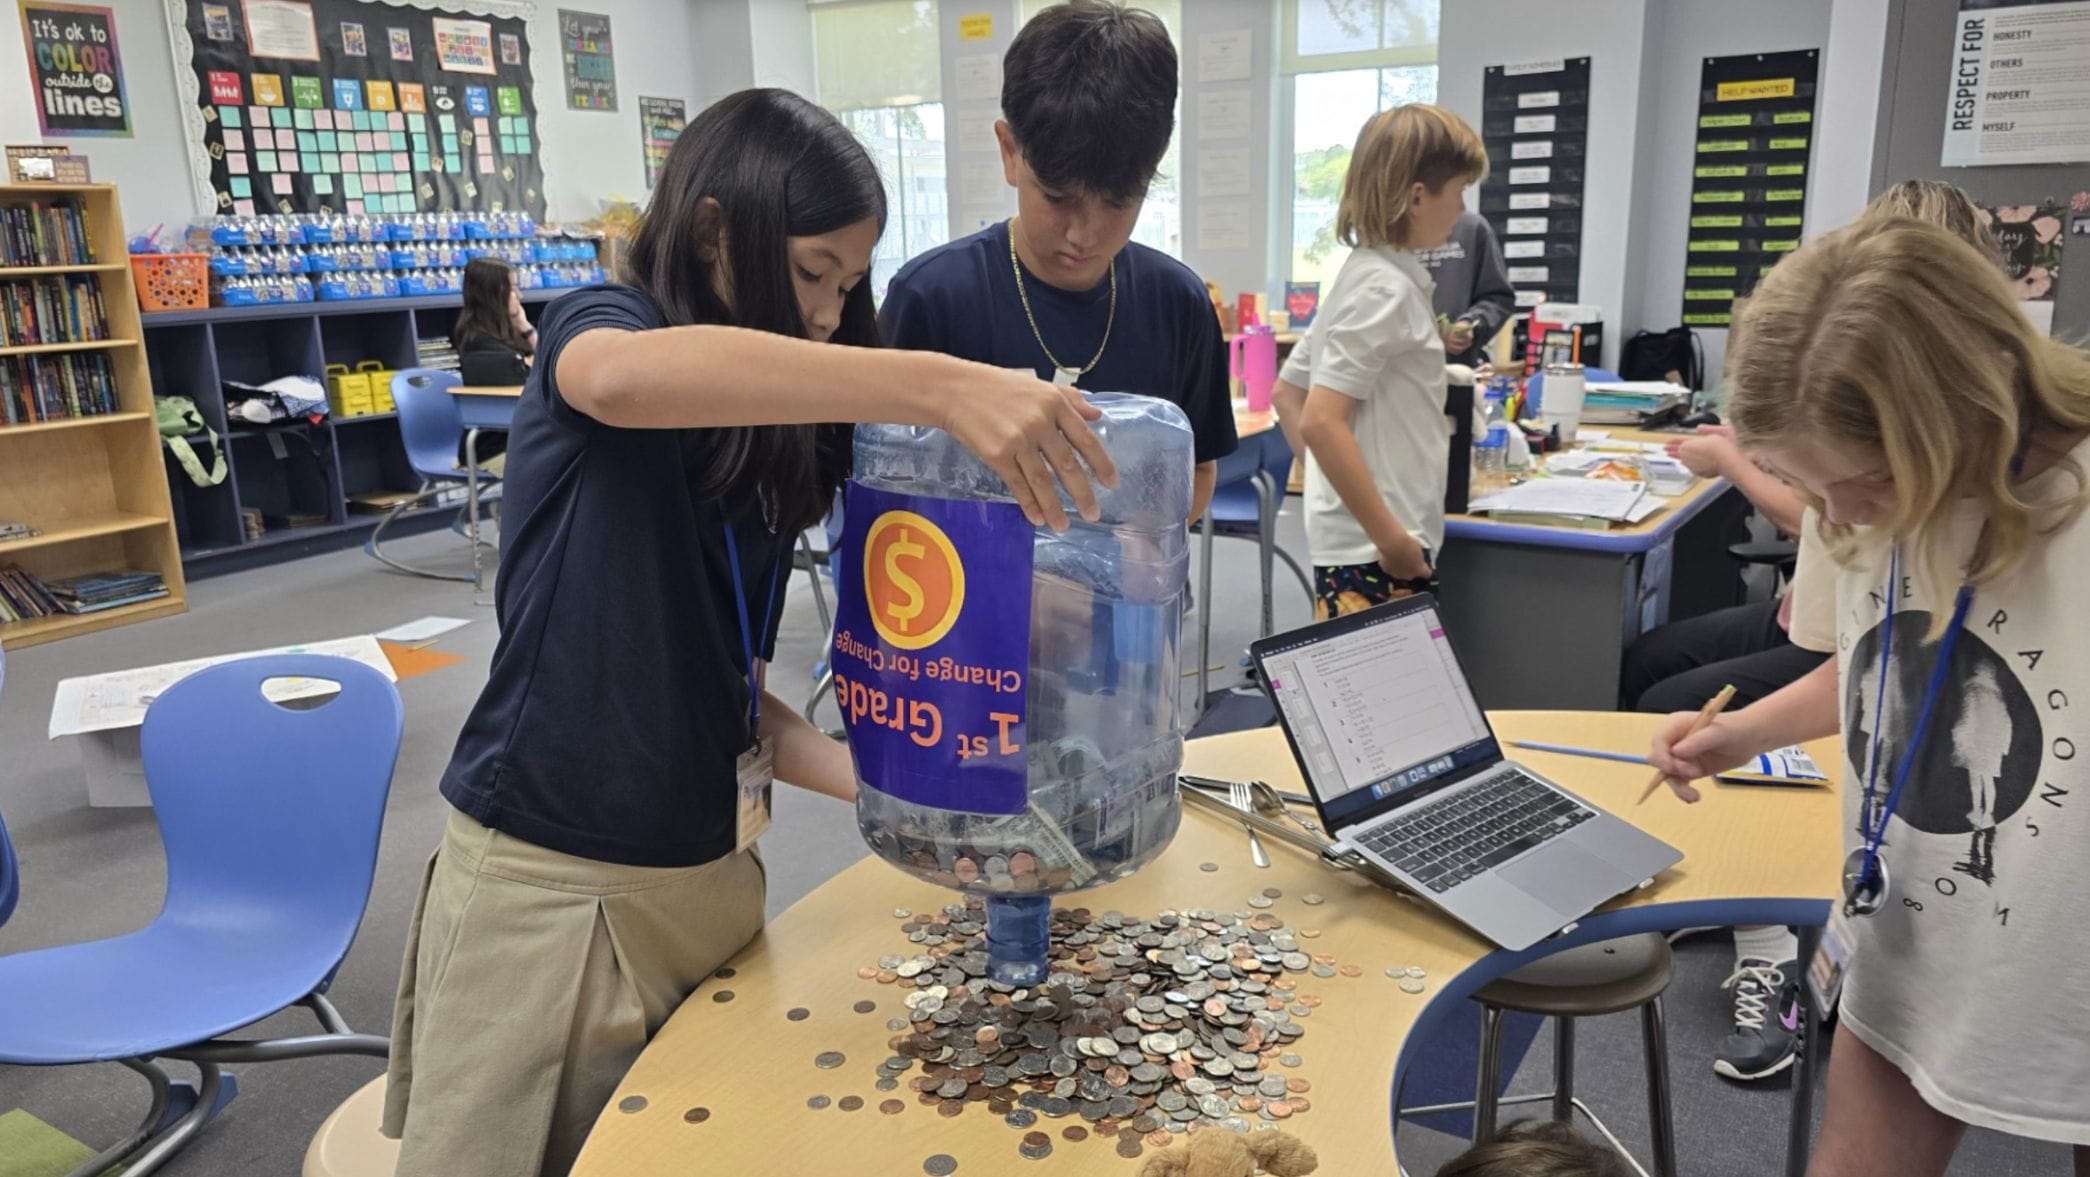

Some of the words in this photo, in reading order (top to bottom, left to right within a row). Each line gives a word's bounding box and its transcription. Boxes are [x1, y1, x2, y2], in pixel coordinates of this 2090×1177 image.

[32, 18, 60, 39] It's
[65, 22, 85, 41] ok
[90, 24, 107, 43] to
[1962, 18, 1985, 52] FOR
[1993, 30, 2032, 41] HONESTY
[36, 41, 113, 74] COLOR
[1990, 58, 2023, 69] OTHERS
[45, 72, 92, 88] outside
[1721, 87, 1745, 96] HELP
[1749, 83, 1789, 93] WANTED
[1952, 57, 1981, 131] RESPECT
[43, 87, 122, 117] lines
[1986, 90, 2031, 101] PROPERTY
[1982, 122, 2016, 132] MYSELF
[836, 630, 885, 672] Change
[889, 654, 920, 681] for
[925, 656, 1022, 694] Change
[835, 674, 943, 748] Grade
[1987, 608, 2076, 838] RAGONS
[956, 711, 1020, 760] 1st
